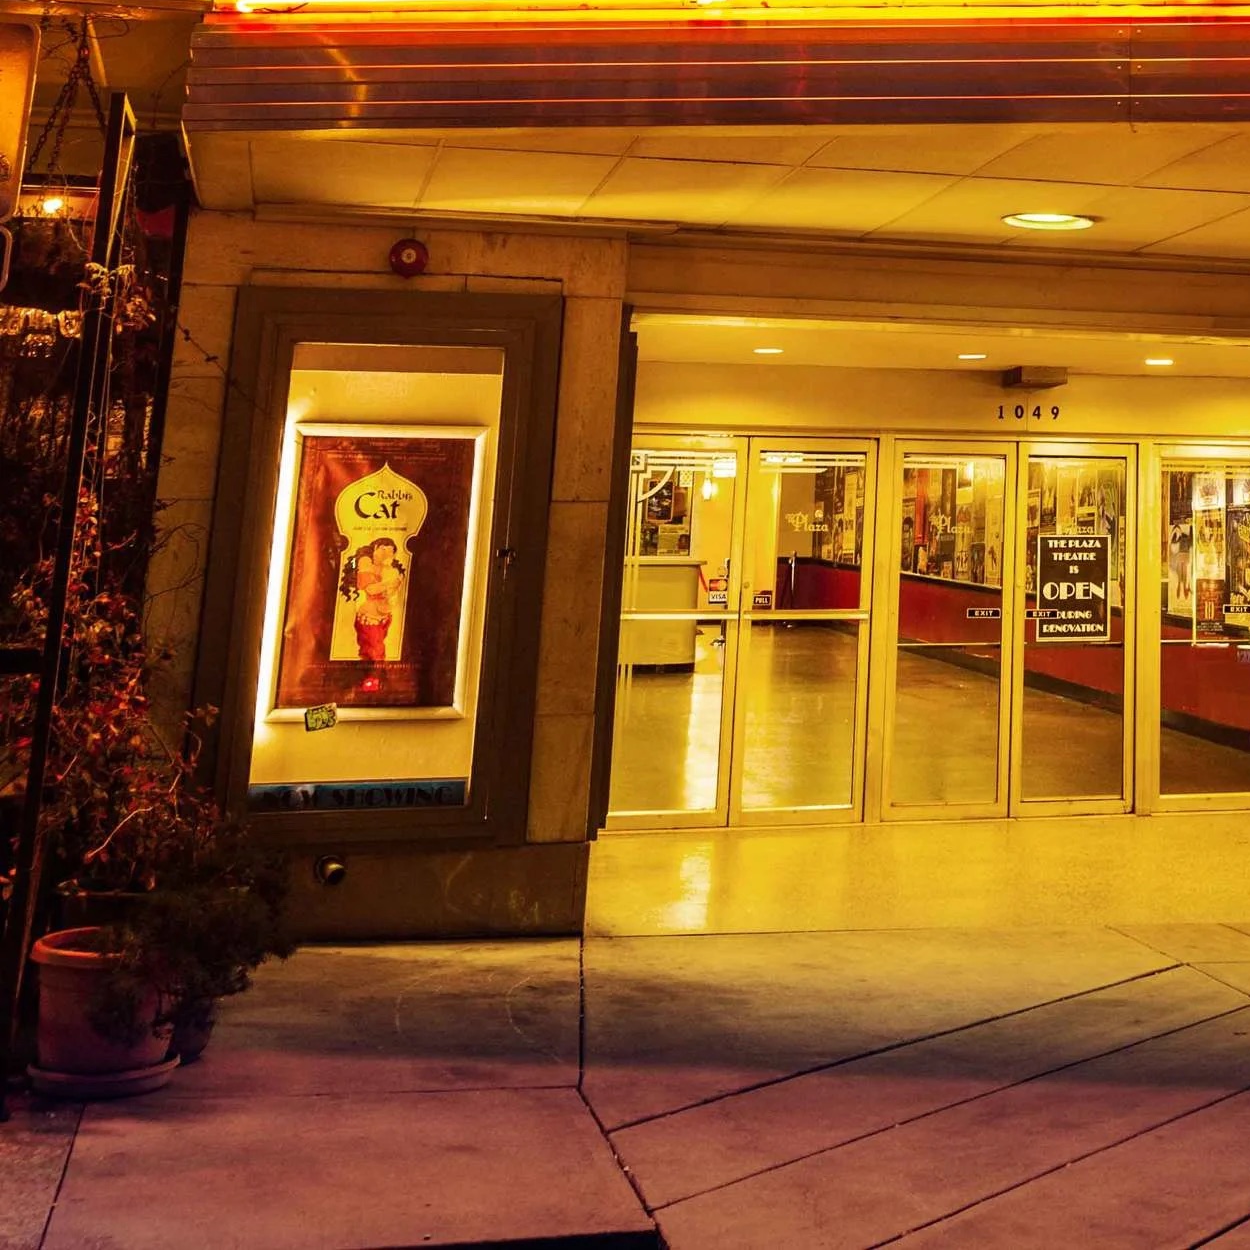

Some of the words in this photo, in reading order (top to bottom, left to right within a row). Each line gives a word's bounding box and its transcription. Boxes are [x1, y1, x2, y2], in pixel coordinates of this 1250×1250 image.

[997, 405, 1060, 420] 1049
[354, 492, 400, 519] Cat
[793, 512, 828, 531] Plaza
[1047, 540, 1067, 548] THE
[1068, 540, 1101, 548] PLAZA
[1052, 552, 1096, 561] THEATRE
[1069, 565, 1079, 574] IS
[1043, 582, 1105, 600] OPEN
[1057, 610, 1092, 619] DURING
[1043, 623, 1104, 633] RENOVATION
